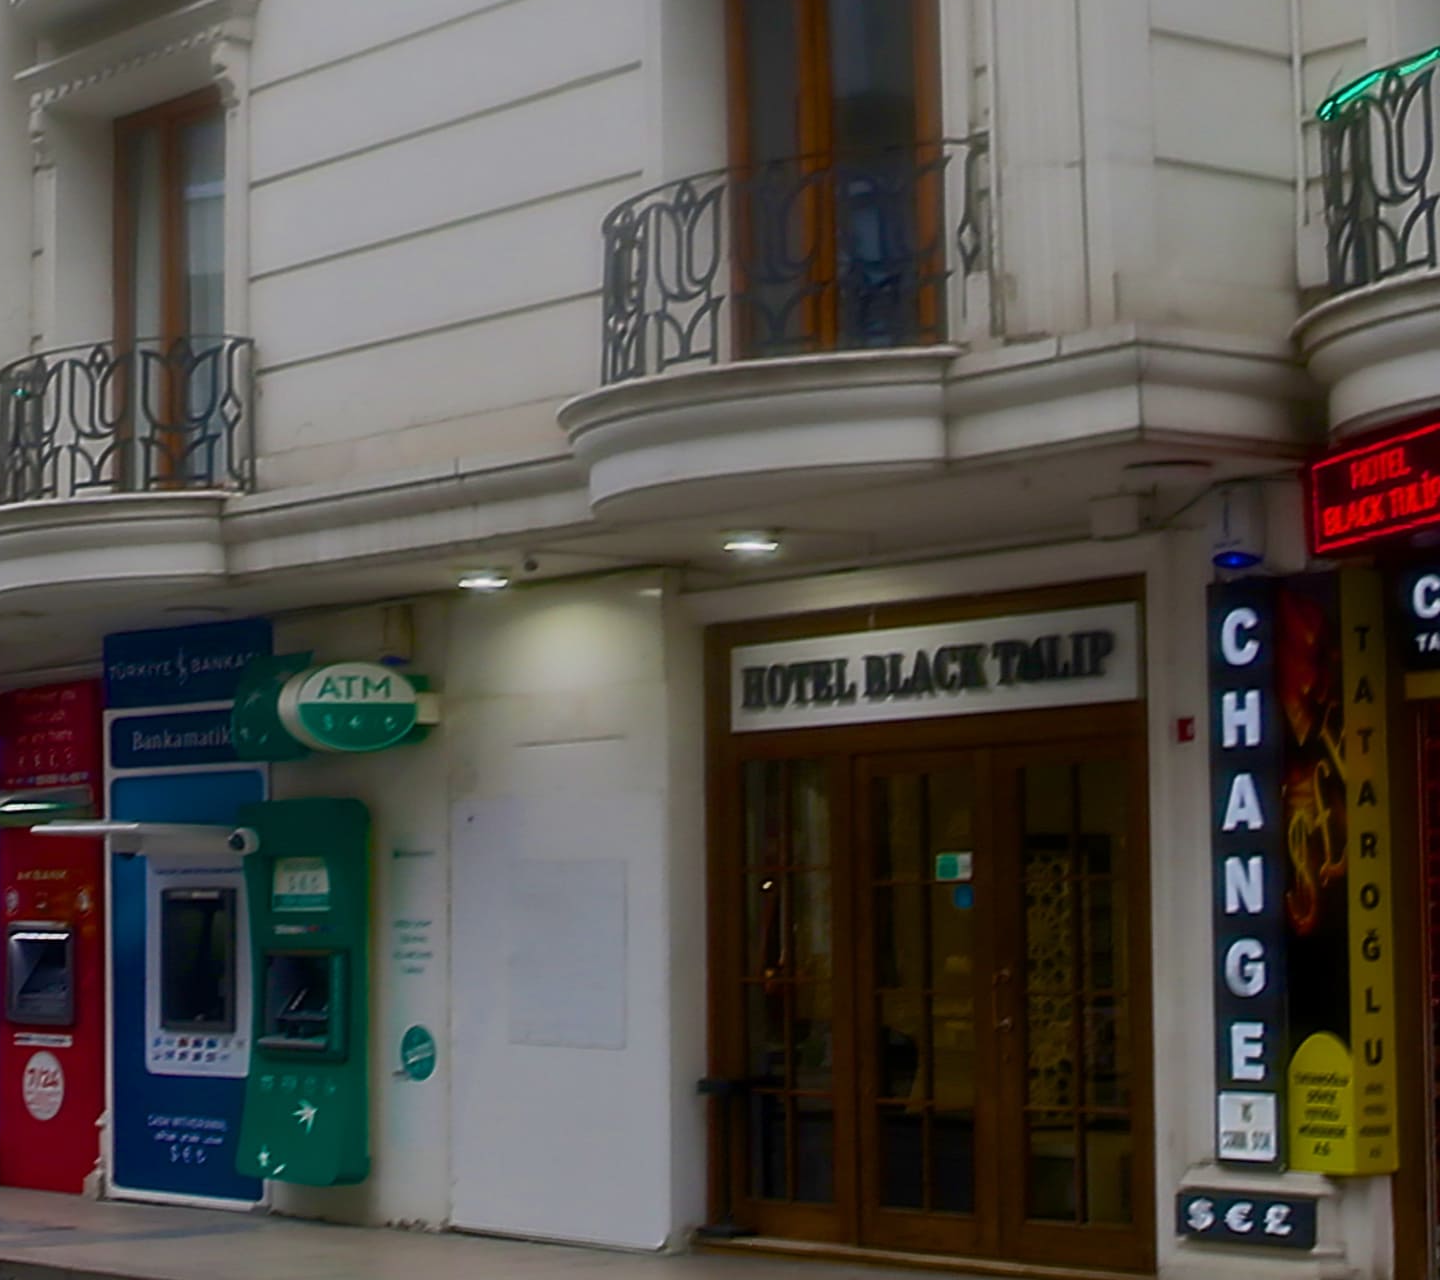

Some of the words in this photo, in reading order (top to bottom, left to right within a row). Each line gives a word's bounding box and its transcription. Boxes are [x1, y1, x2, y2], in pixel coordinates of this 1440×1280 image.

[1348, 445, 1413, 491] HOTEL
[1322, 493, 1388, 538] BLACK
[190, 651, 260, 676] BANKA
[742, 657, 856, 710] HOTEL
[863, 643, 988, 699] BLACK
[993, 630, 1115, 686] TULIP
[317, 676, 393, 699] ATM
[132, 725, 234, 752] Bankamatik
[1220, 606, 1267, 1081] CHANGE
[1353, 625, 1382, 1065] TATAROĞLU
[1185, 1196, 1217, 1232] $
[1223, 1200, 1255, 1234] €
[1263, 1202, 1294, 1238] £
